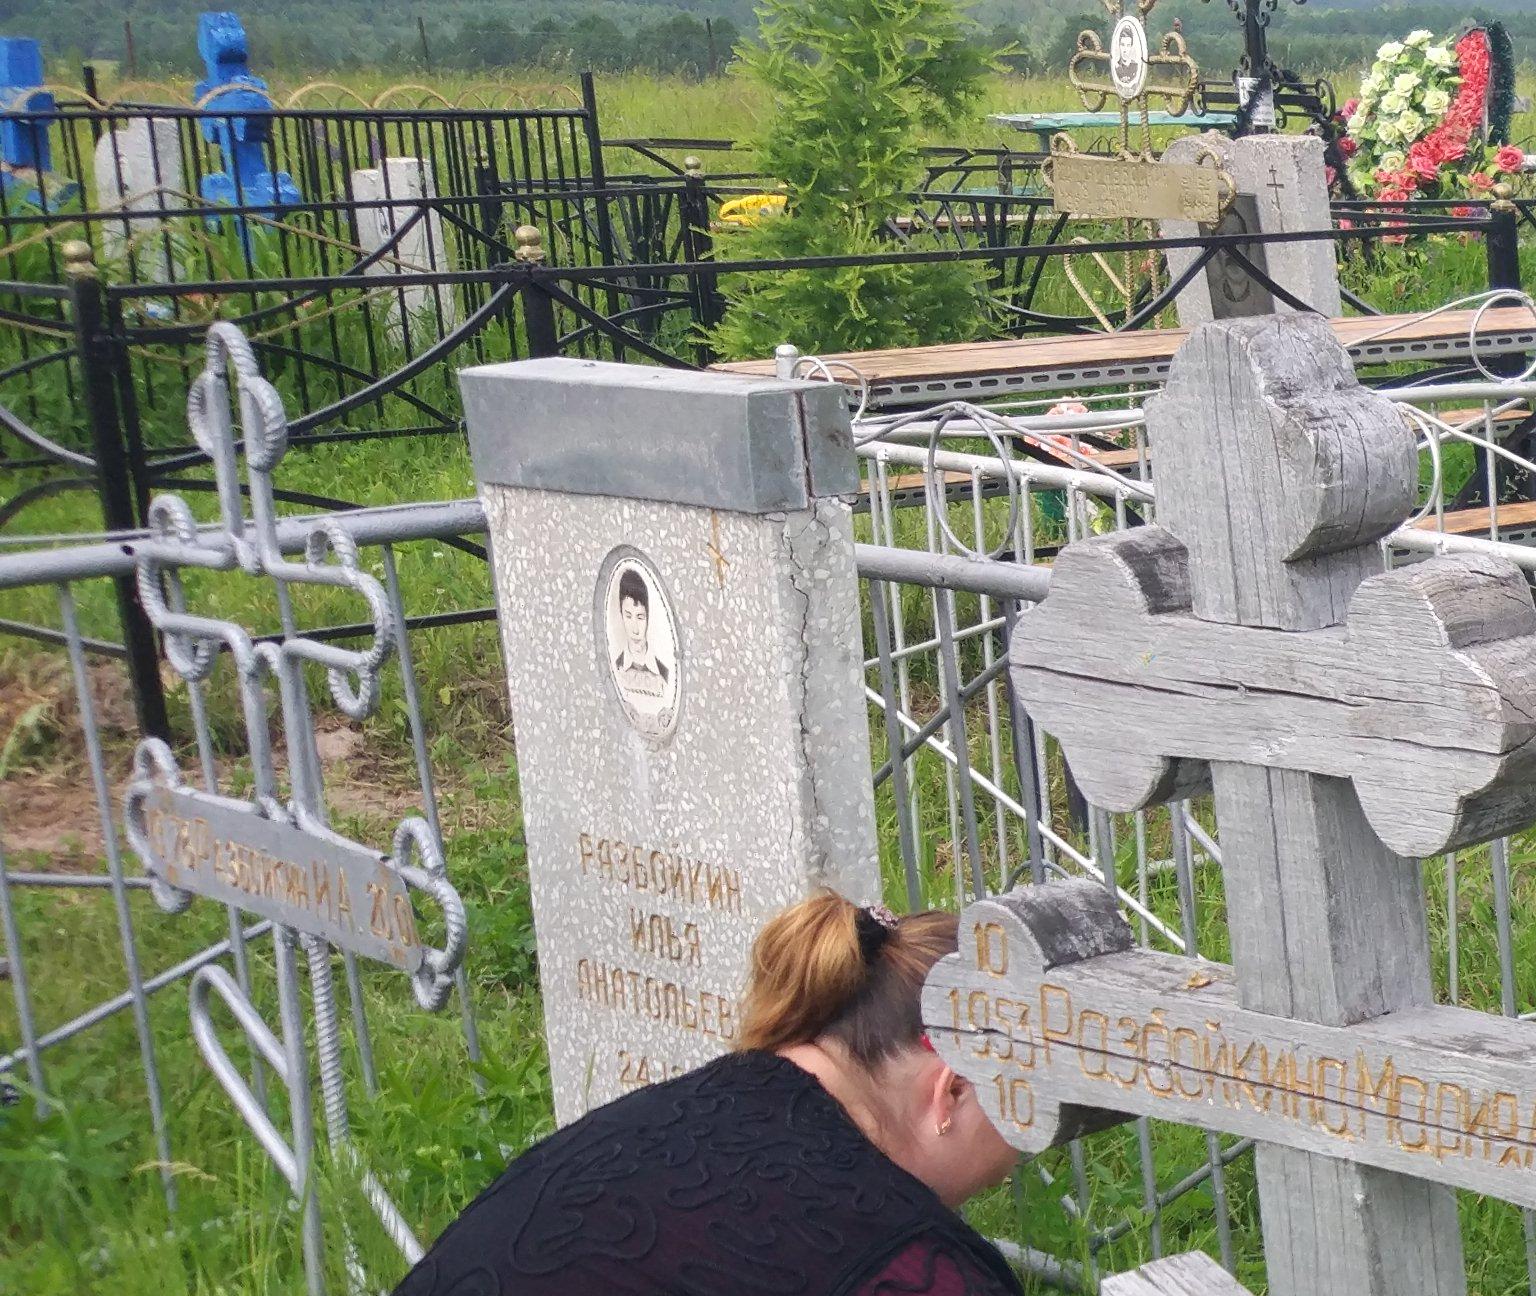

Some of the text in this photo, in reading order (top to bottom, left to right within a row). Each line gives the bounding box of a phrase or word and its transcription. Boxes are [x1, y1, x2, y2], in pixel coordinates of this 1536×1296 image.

[580, 833, 742, 915] РАЗБОЙКИН
[630, 904, 701, 969] ИЛЬЯ
[974, 921, 1009, 978] 10
[578, 957, 735, 1040] АНАТОЛЬЕВ
[948, 987, 1037, 1071] 1953
[992, 1073, 1035, 1130] 10
